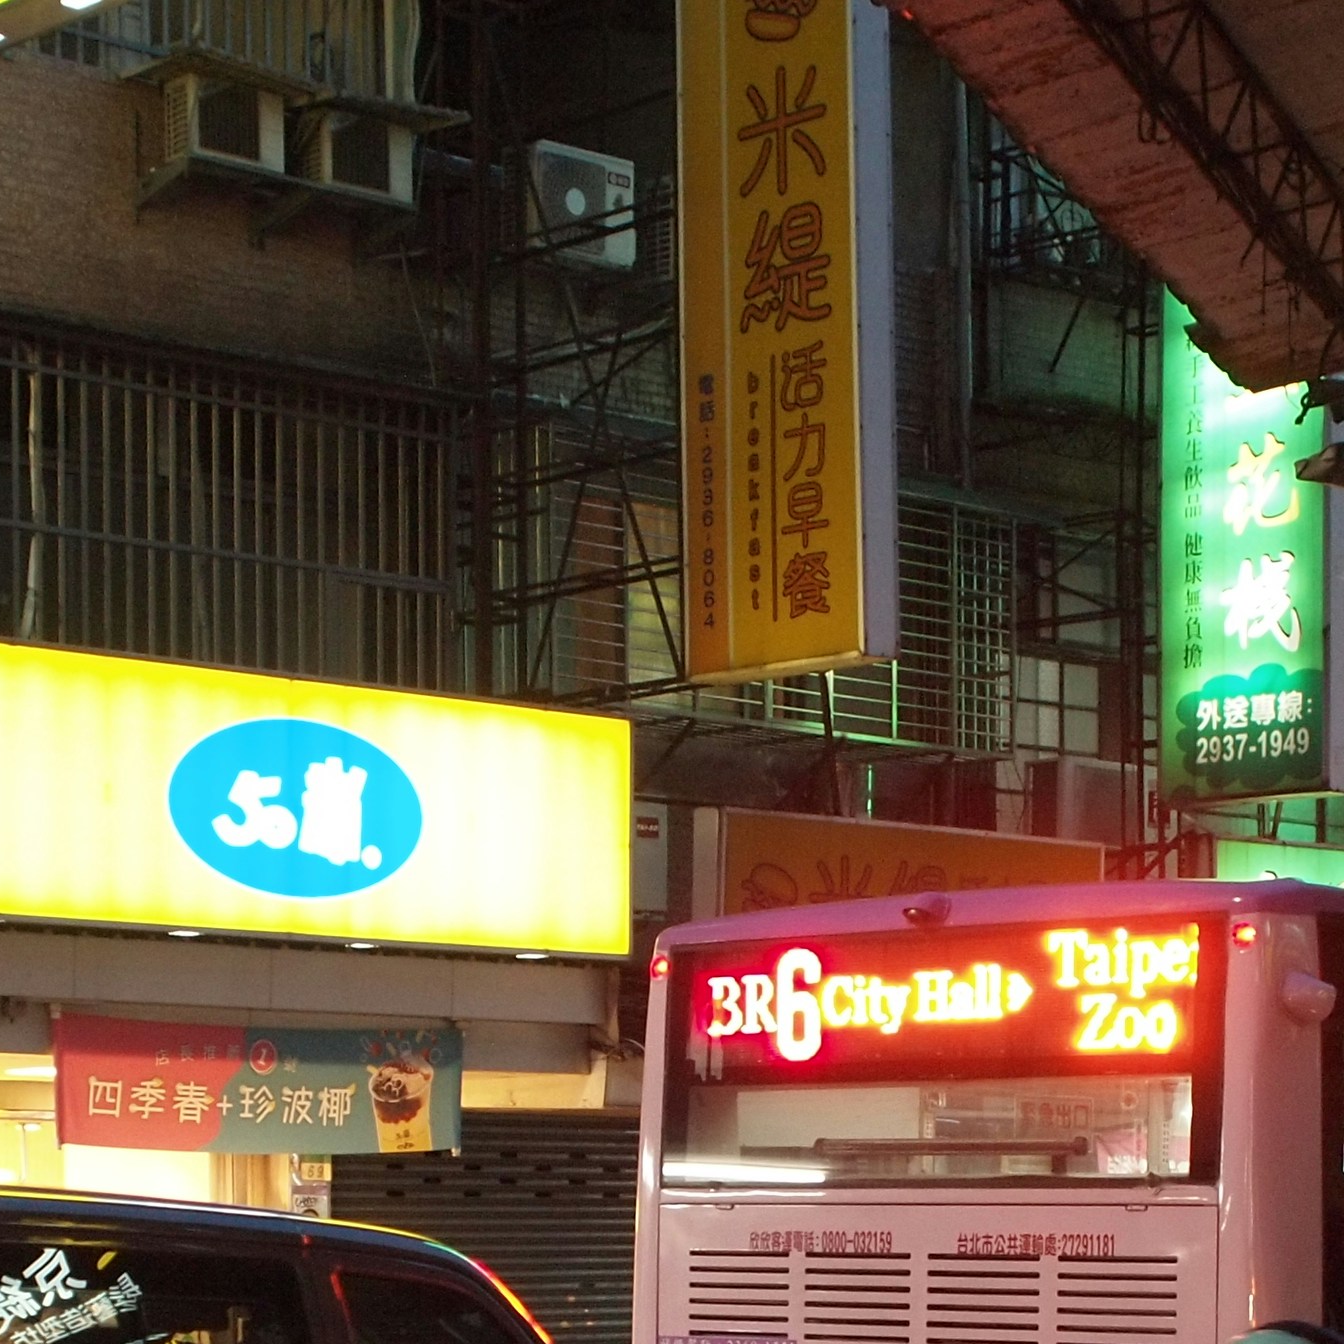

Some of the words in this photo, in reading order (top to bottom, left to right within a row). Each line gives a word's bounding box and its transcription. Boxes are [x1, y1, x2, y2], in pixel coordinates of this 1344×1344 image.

[777, 339, 831, 620] 活力早餐
[1196, 727, 1309, 764] 2937-1949
[912, 965, 1002, 1021] Hall
[1077, 993, 1179, 1053] Zoo
